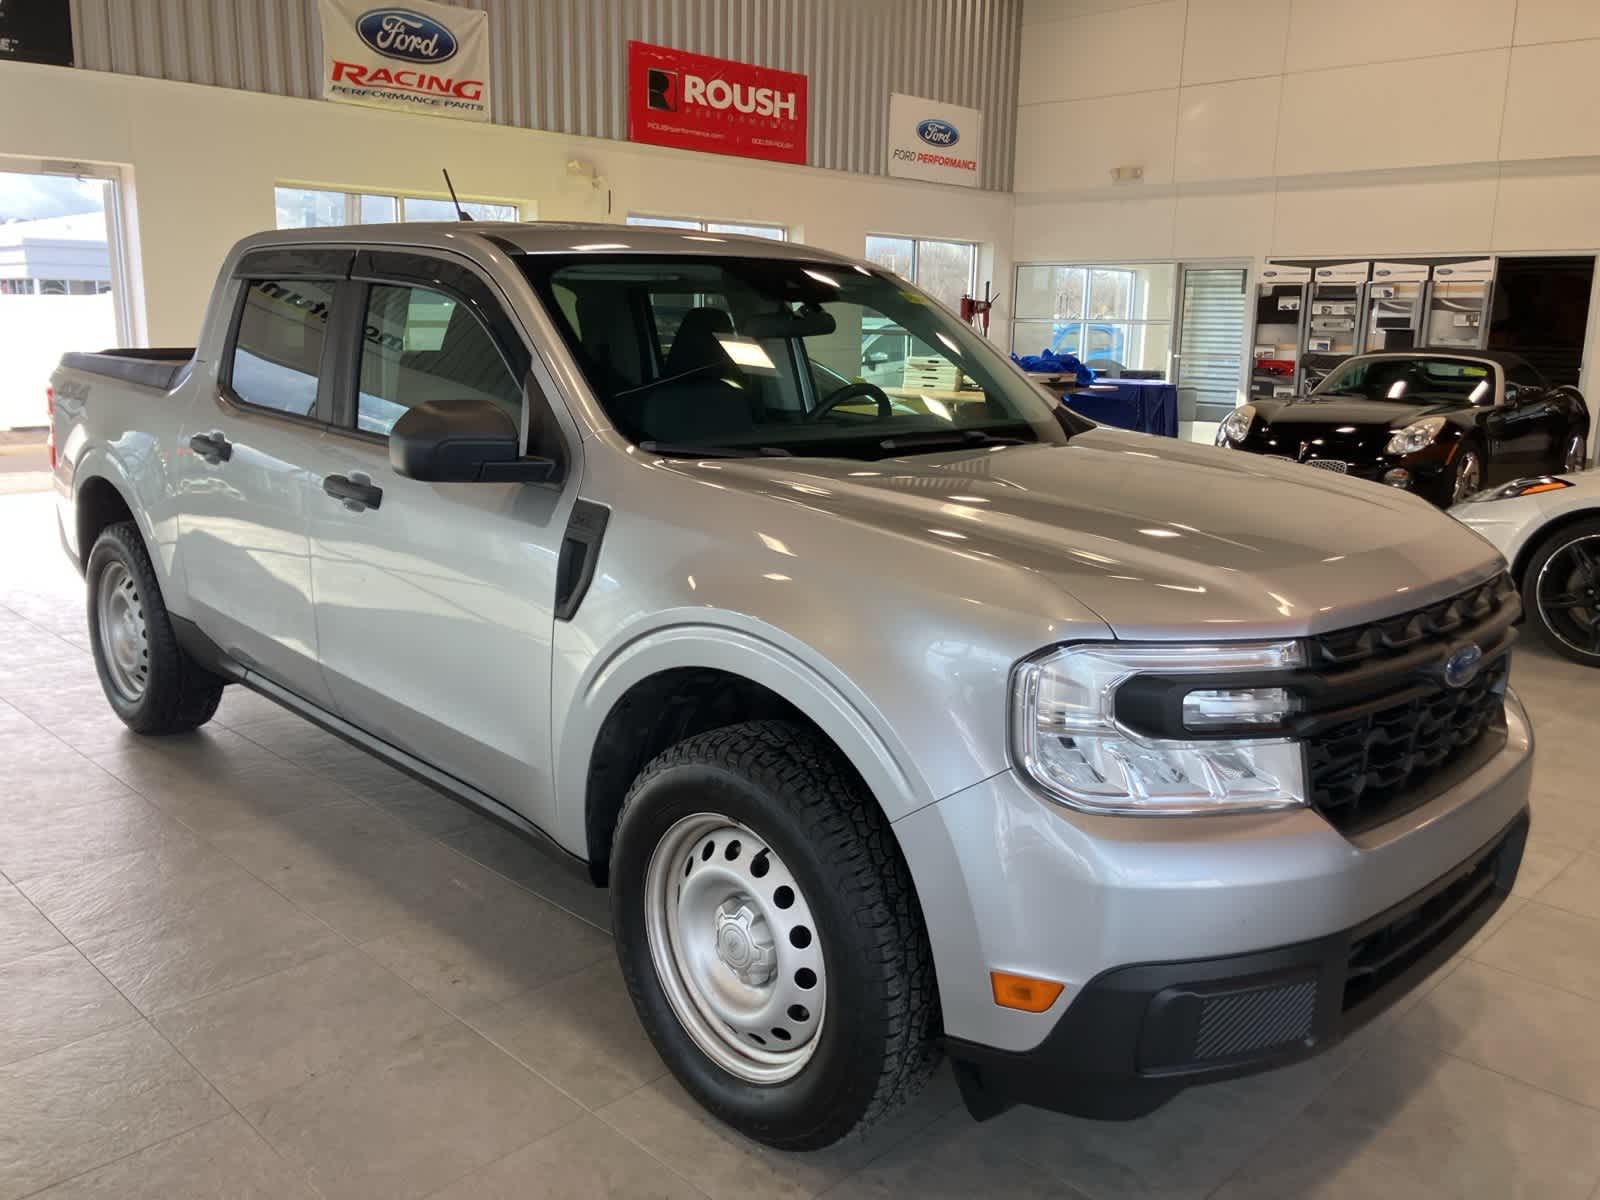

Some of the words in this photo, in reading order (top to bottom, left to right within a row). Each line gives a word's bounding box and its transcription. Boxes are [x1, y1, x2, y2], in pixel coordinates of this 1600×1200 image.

[377, 15, 439, 56] Ford
[331, 60, 484, 101] RACING
[684, 74, 795, 120] ROUSH
[332, 85, 441, 107] PERFORMANCE
[444, 100, 484, 111] PARTS
[924, 123, 951, 143] Ford
[893, 149, 916, 161] FORD
[917, 153, 976, 171] PERFORMANCE
